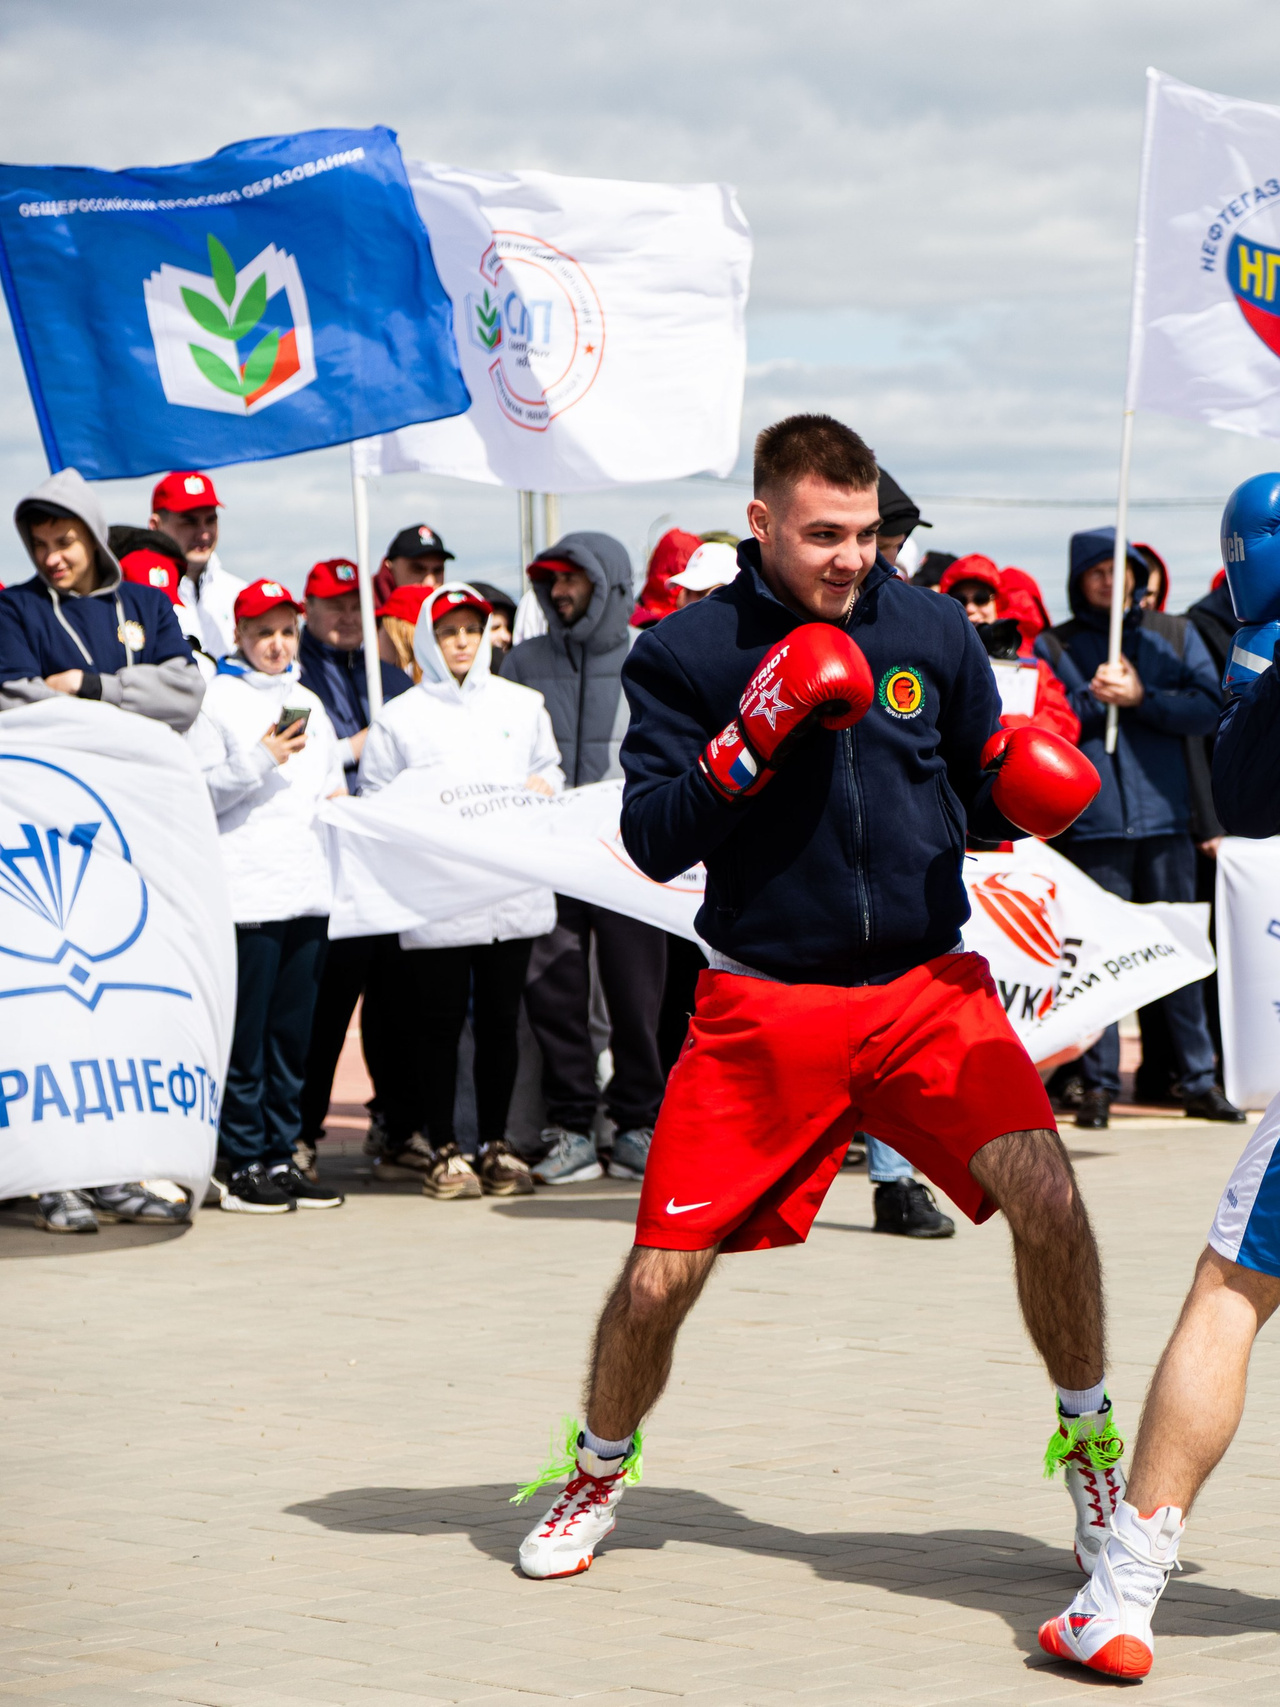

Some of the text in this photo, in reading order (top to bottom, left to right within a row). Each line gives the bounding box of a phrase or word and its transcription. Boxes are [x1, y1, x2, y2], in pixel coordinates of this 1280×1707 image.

[241, 147, 365, 199] ОБРАЗОВАНИЯ
[758, 671, 775, 691] TEAM
[1103, 944, 1179, 981] регион
